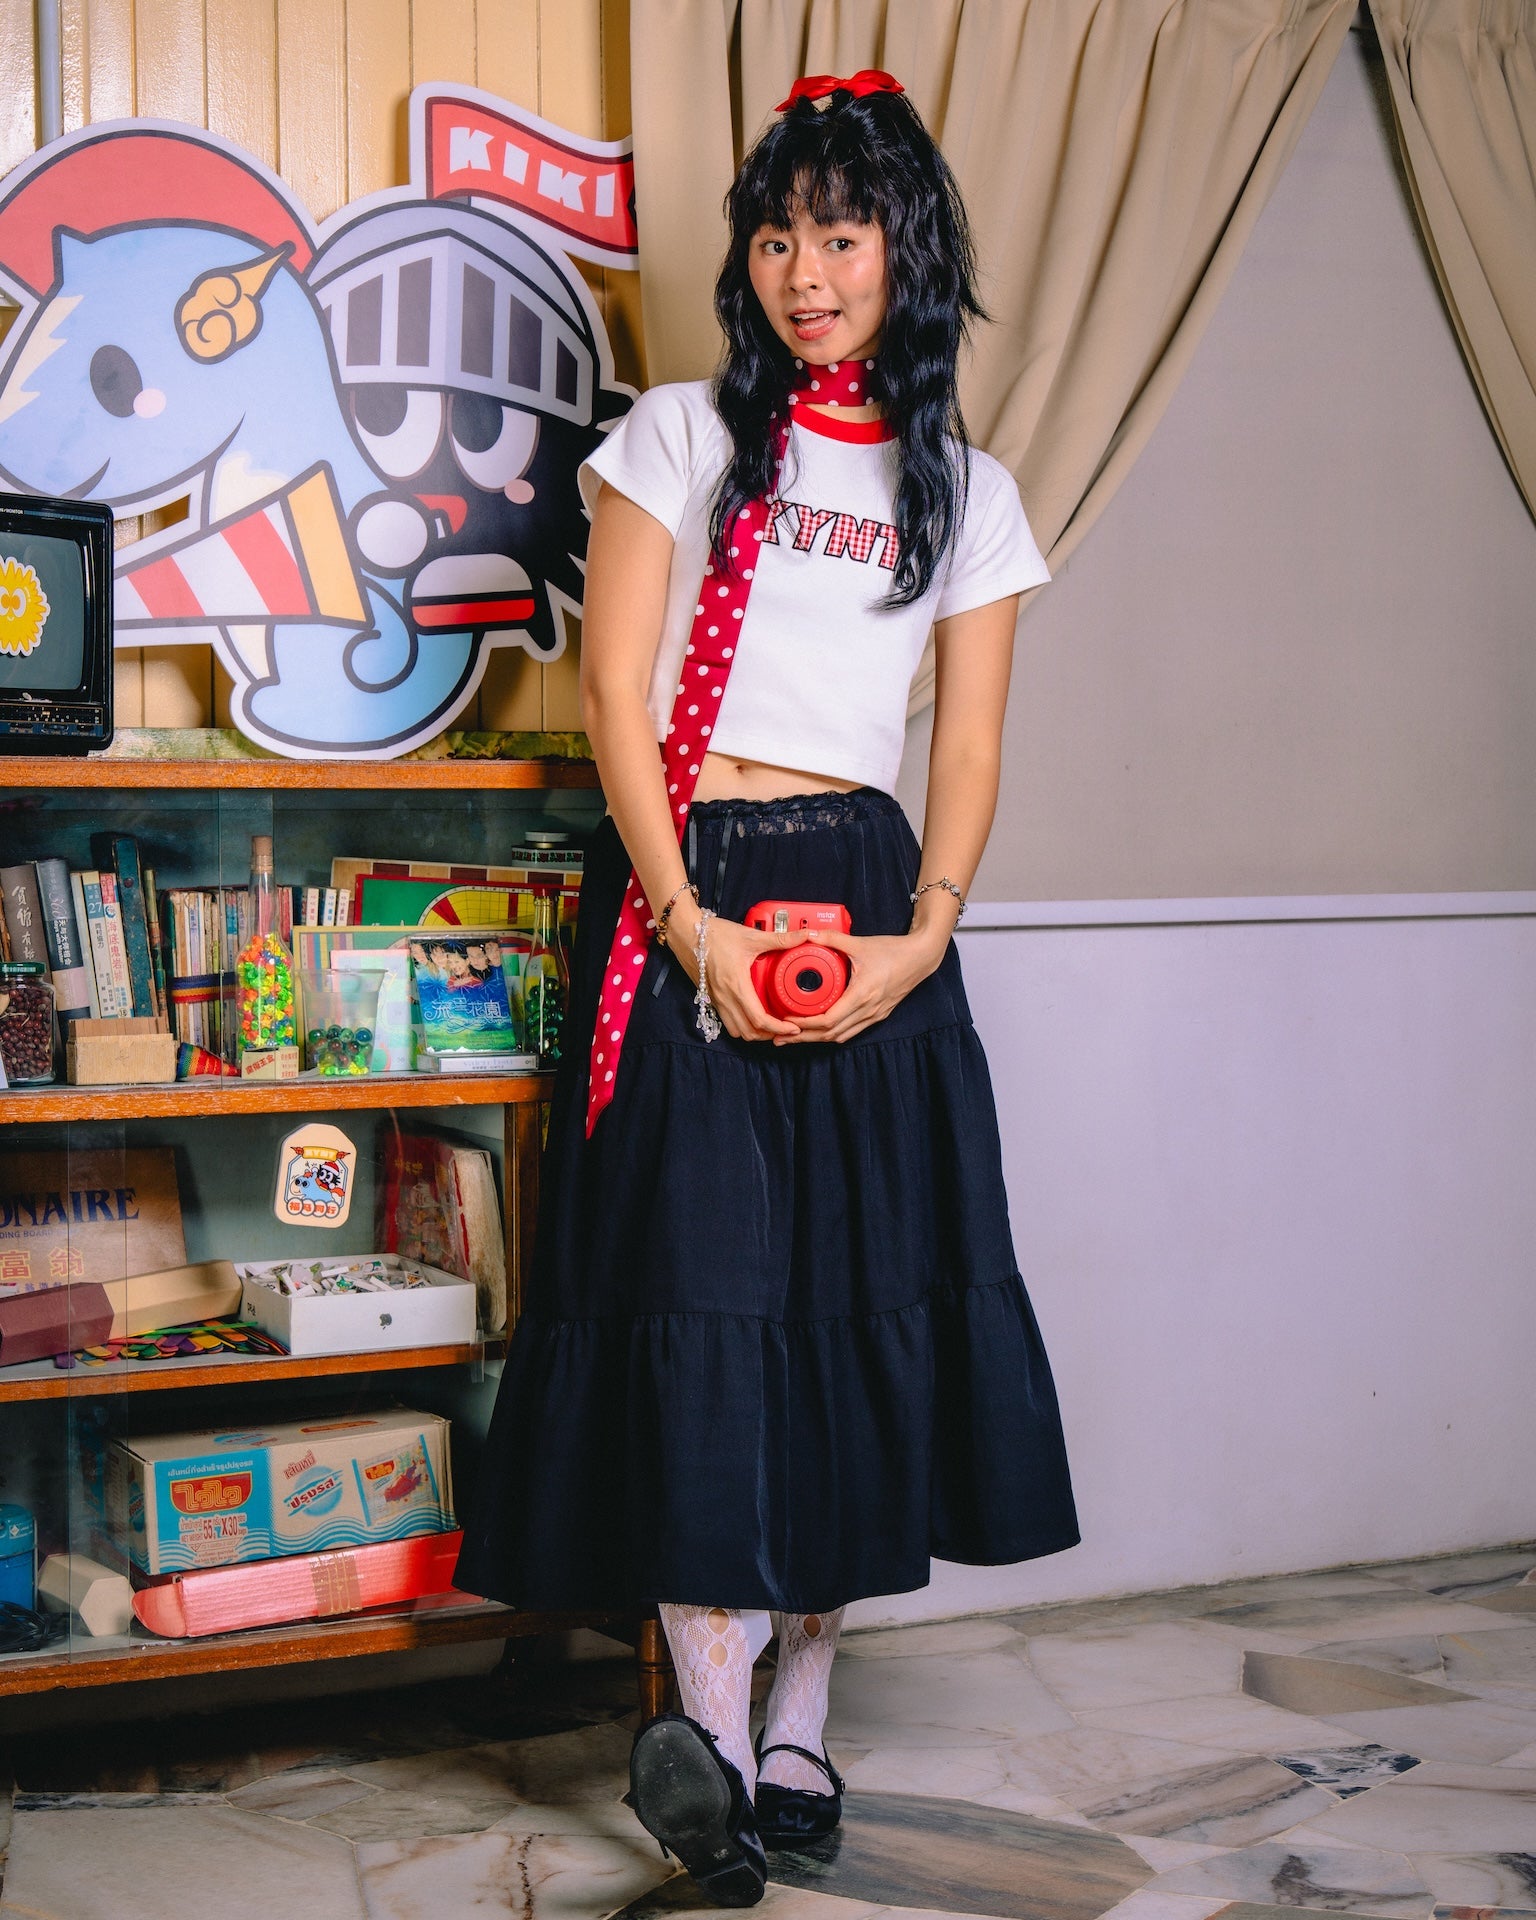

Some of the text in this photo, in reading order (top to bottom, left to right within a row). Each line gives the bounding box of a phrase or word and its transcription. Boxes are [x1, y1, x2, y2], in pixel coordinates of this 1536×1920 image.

[450, 126, 615, 217] KIKI
[88, 902, 101, 914] 27
[817, 911, 835, 919] instax
[290, 1478, 336, 1509] ปรุงรส
[203, 1519, 213, 1540] 55
